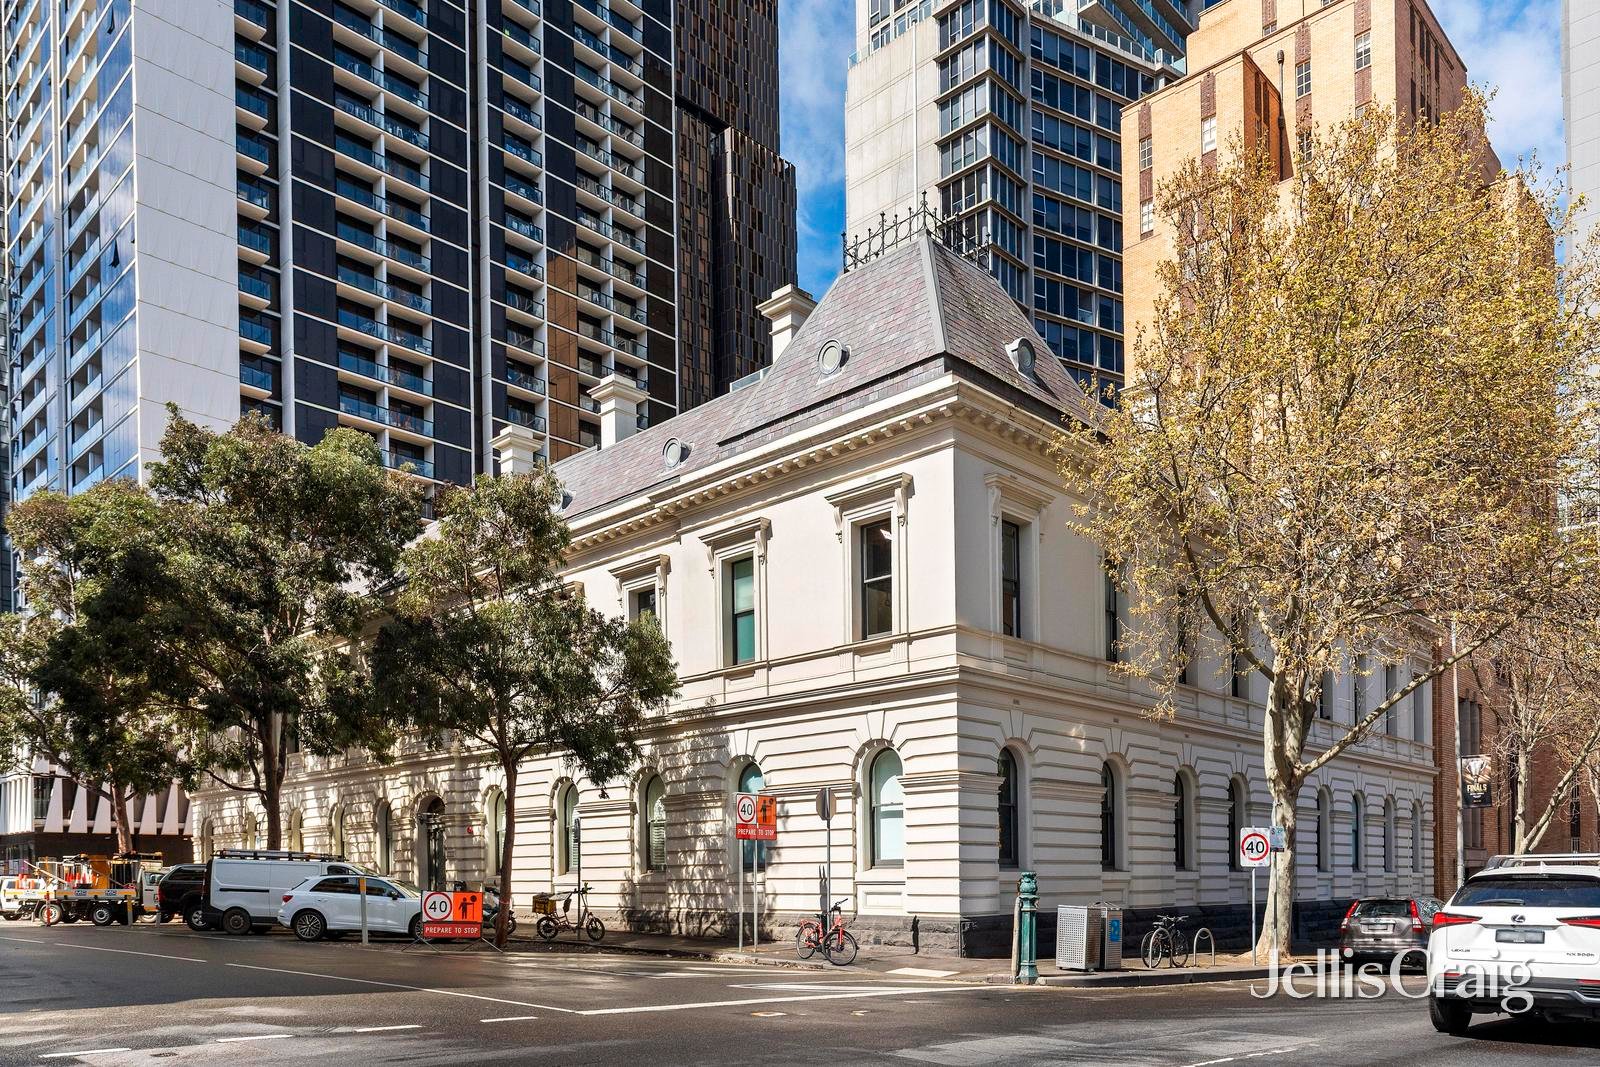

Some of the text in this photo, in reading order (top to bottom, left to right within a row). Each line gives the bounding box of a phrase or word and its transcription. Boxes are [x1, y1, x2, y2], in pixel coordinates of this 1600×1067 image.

[741, 804, 753, 816] 40
[1245, 841, 1265, 854] 40
[429, 900, 448, 913] 40
